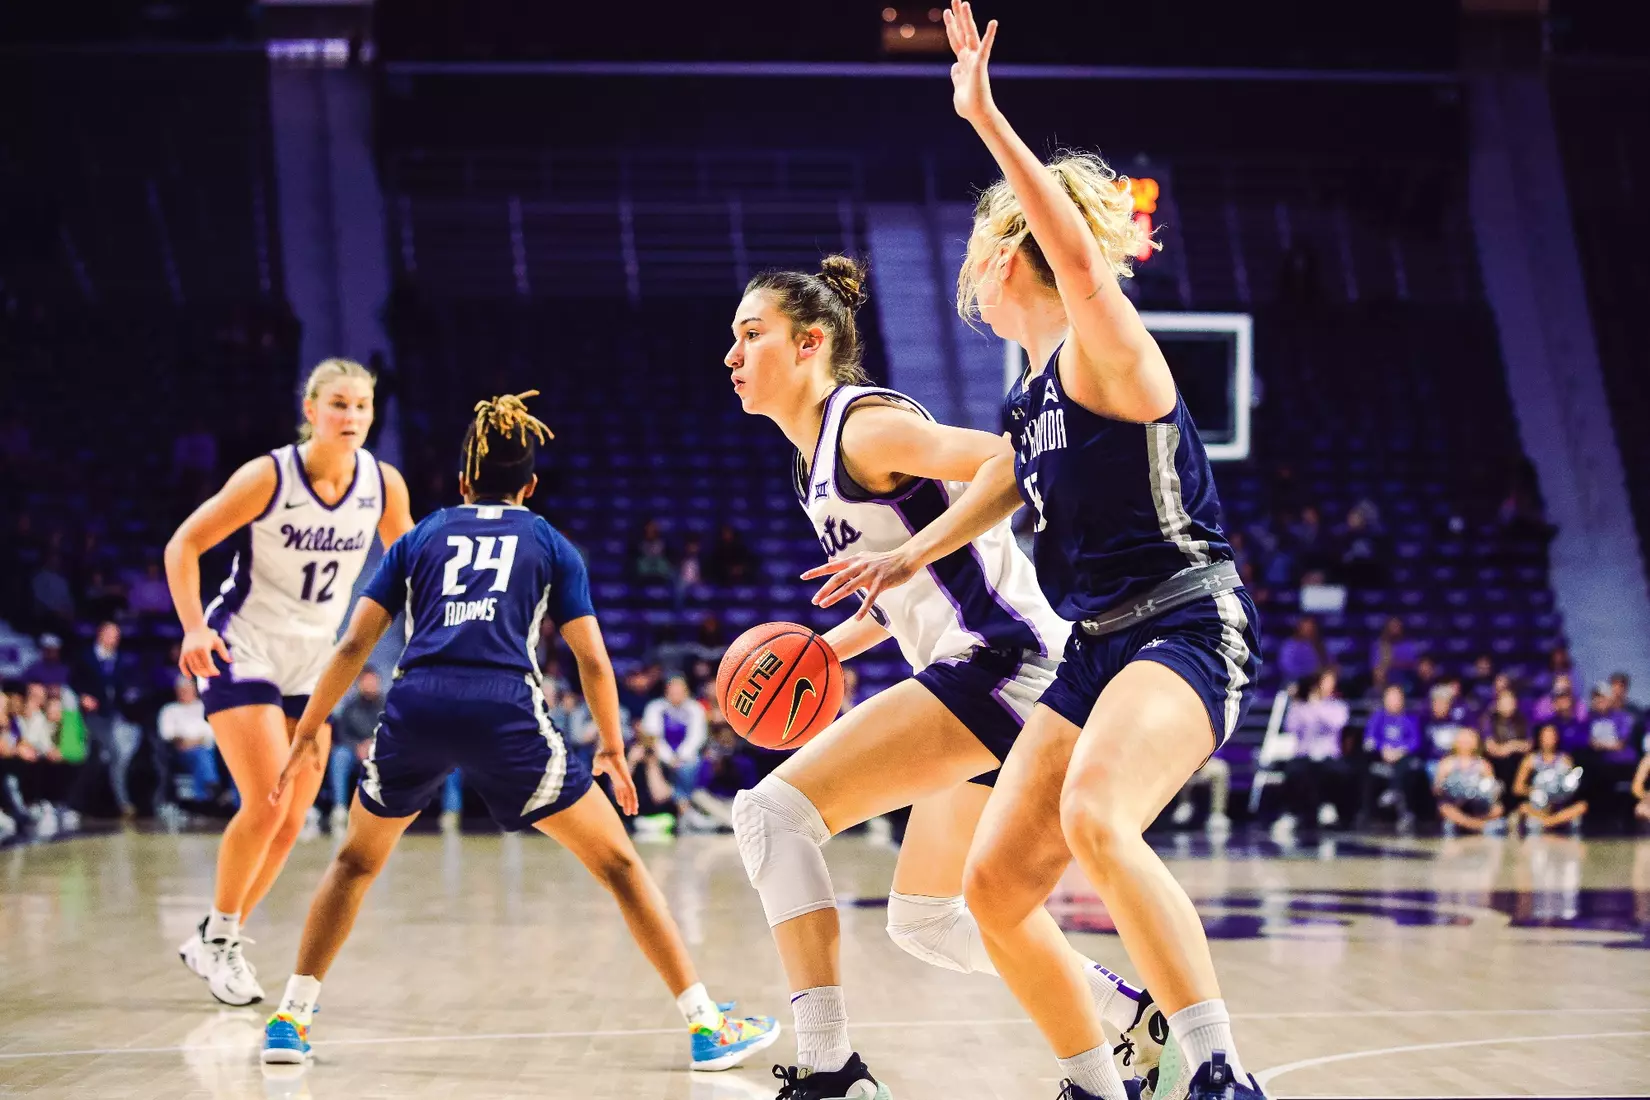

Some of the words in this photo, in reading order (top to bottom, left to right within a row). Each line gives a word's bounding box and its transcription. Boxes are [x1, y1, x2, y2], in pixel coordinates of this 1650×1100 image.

[300, 560, 339, 603] 12
[441, 534, 519, 596] 24
[443, 597, 498, 627] ADAMS
[733, 651, 784, 718] ELITE
